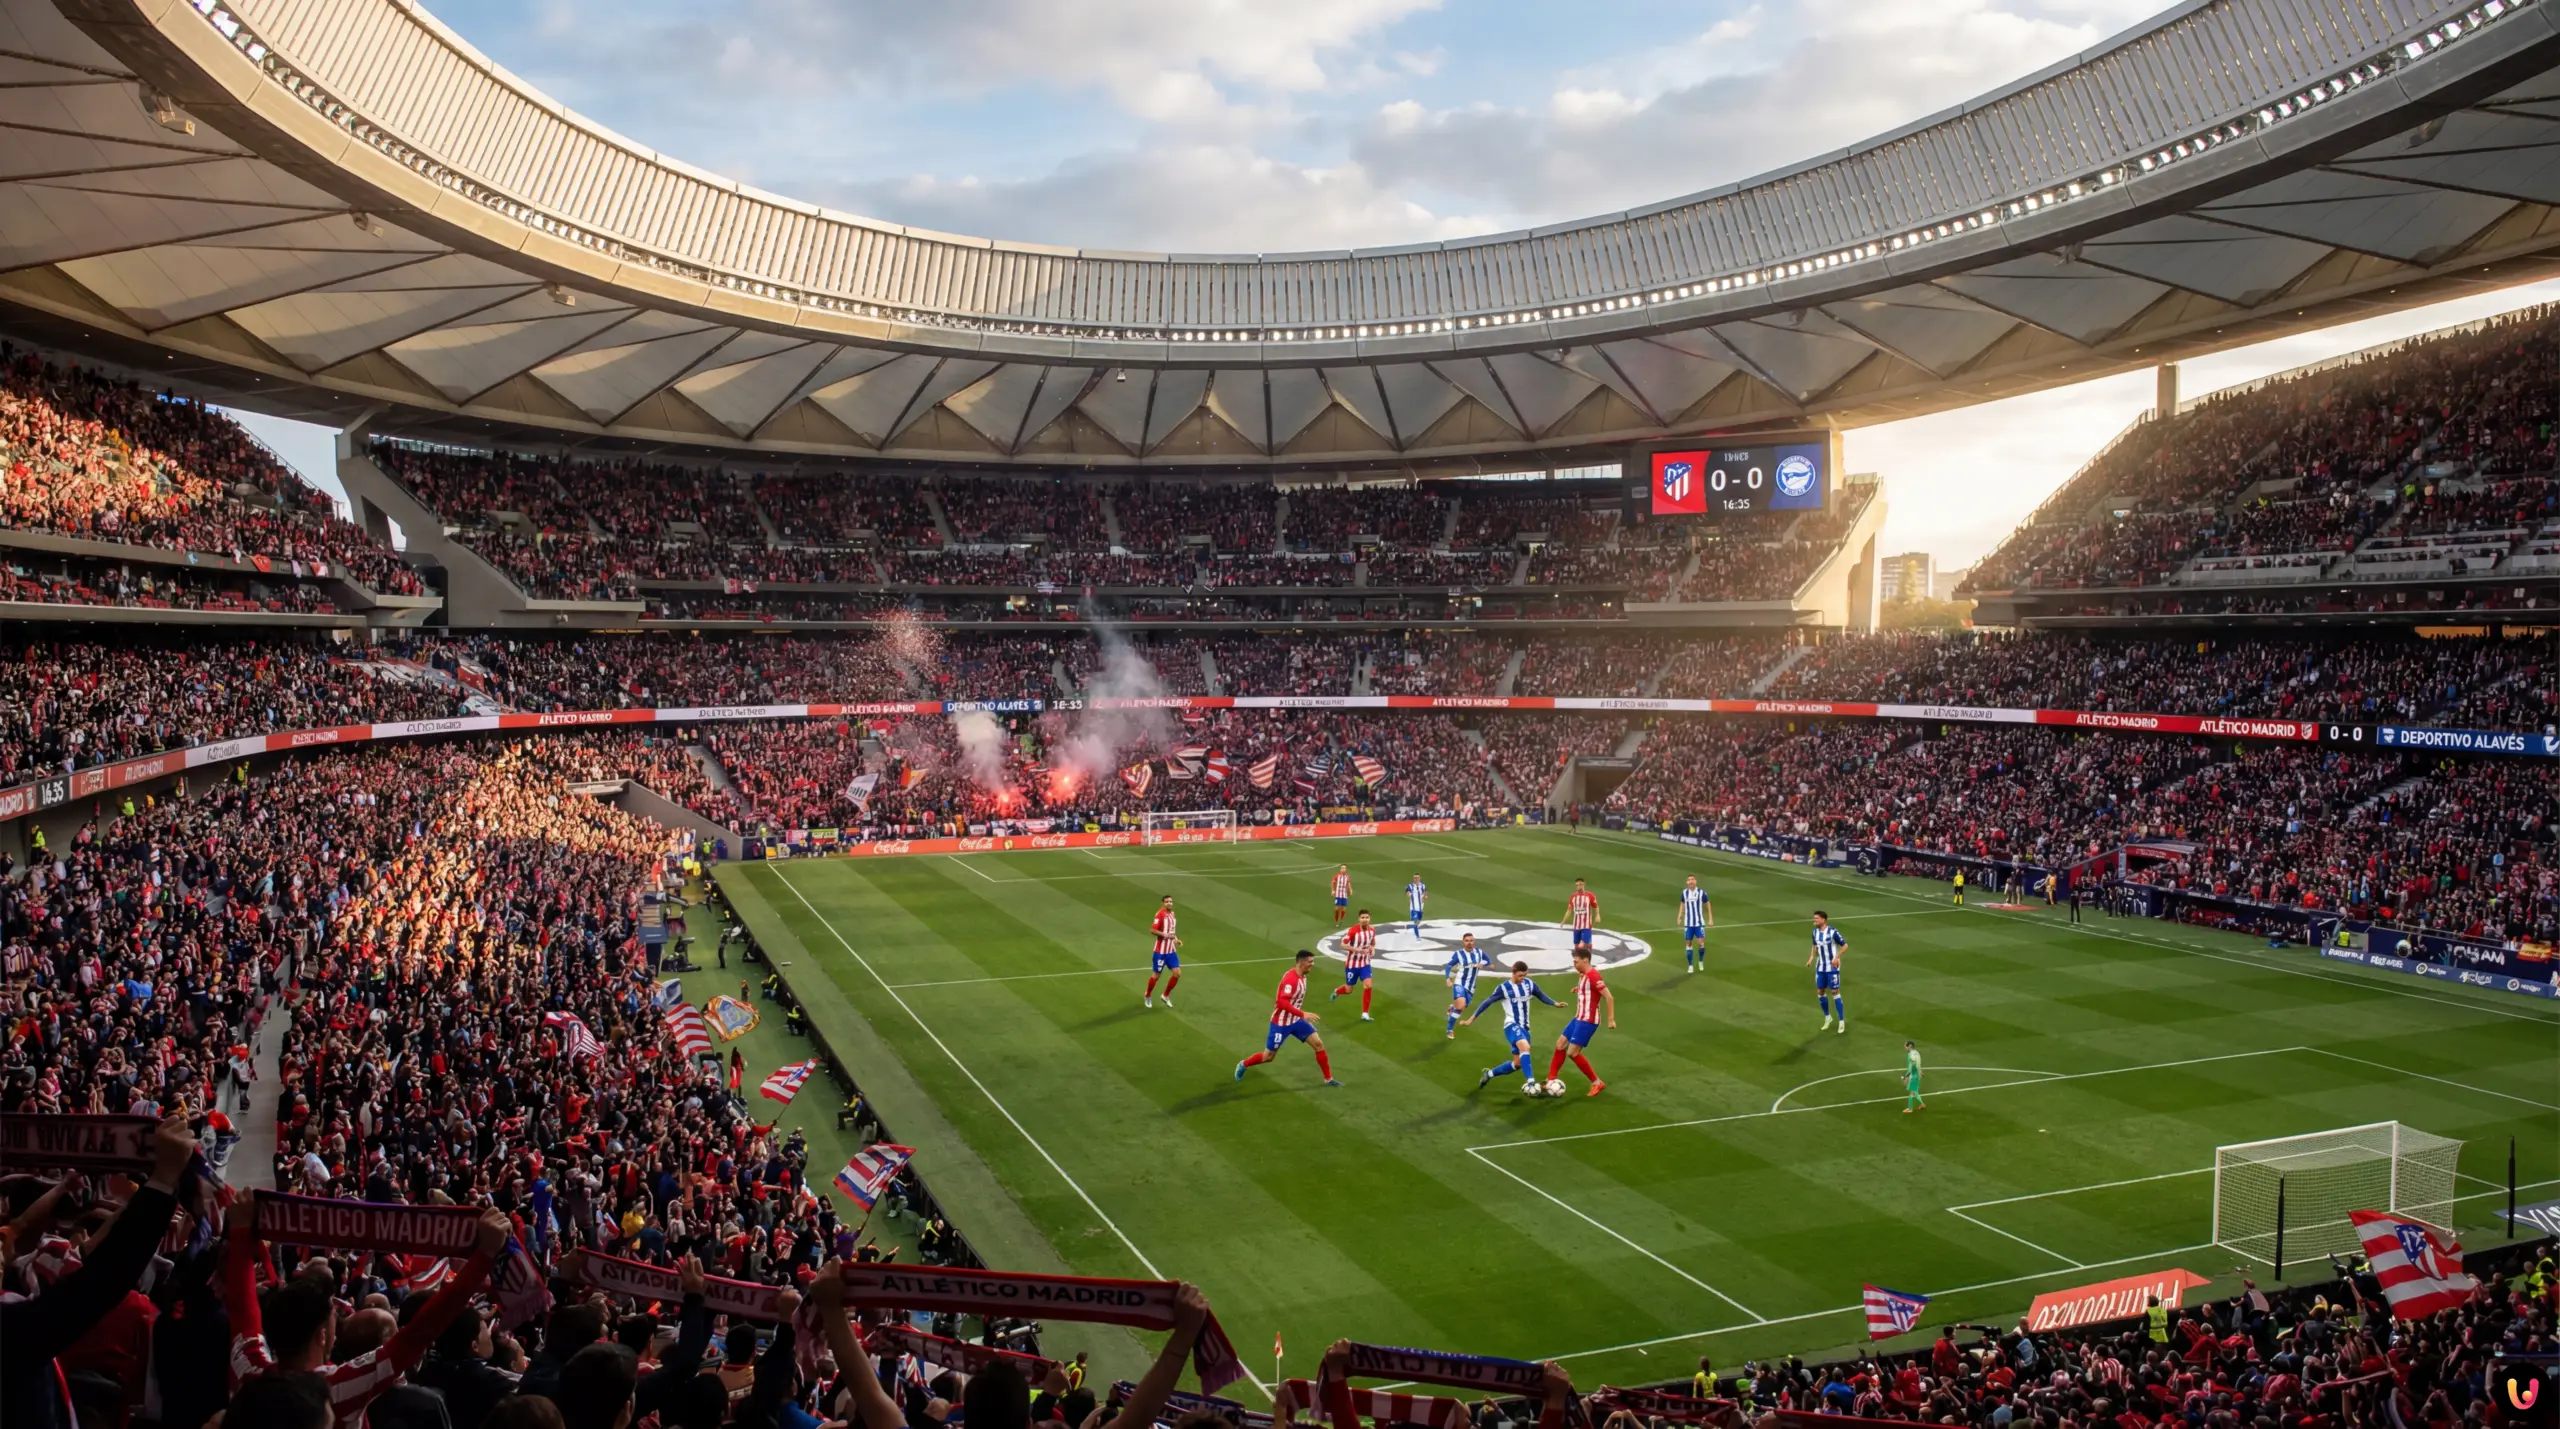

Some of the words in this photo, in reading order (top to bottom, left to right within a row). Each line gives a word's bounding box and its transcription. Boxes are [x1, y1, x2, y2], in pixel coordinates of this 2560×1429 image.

[1711, 470, 1726, 491] 0
[1747, 467, 1763, 489] 0
[2251, 723, 2296, 737] MADRID
[2330, 726, 2339, 740] 0
[2352, 727, 2362, 741] 0
[2401, 730, 2471, 748] DEPORTIVO
[2474, 732, 2525, 751] ALAVÉS
[375, 1210, 478, 1248] MADRID
[881, 1275, 1019, 1299] ATLÉTICO
[1028, 1284, 1146, 1307] MADRID
